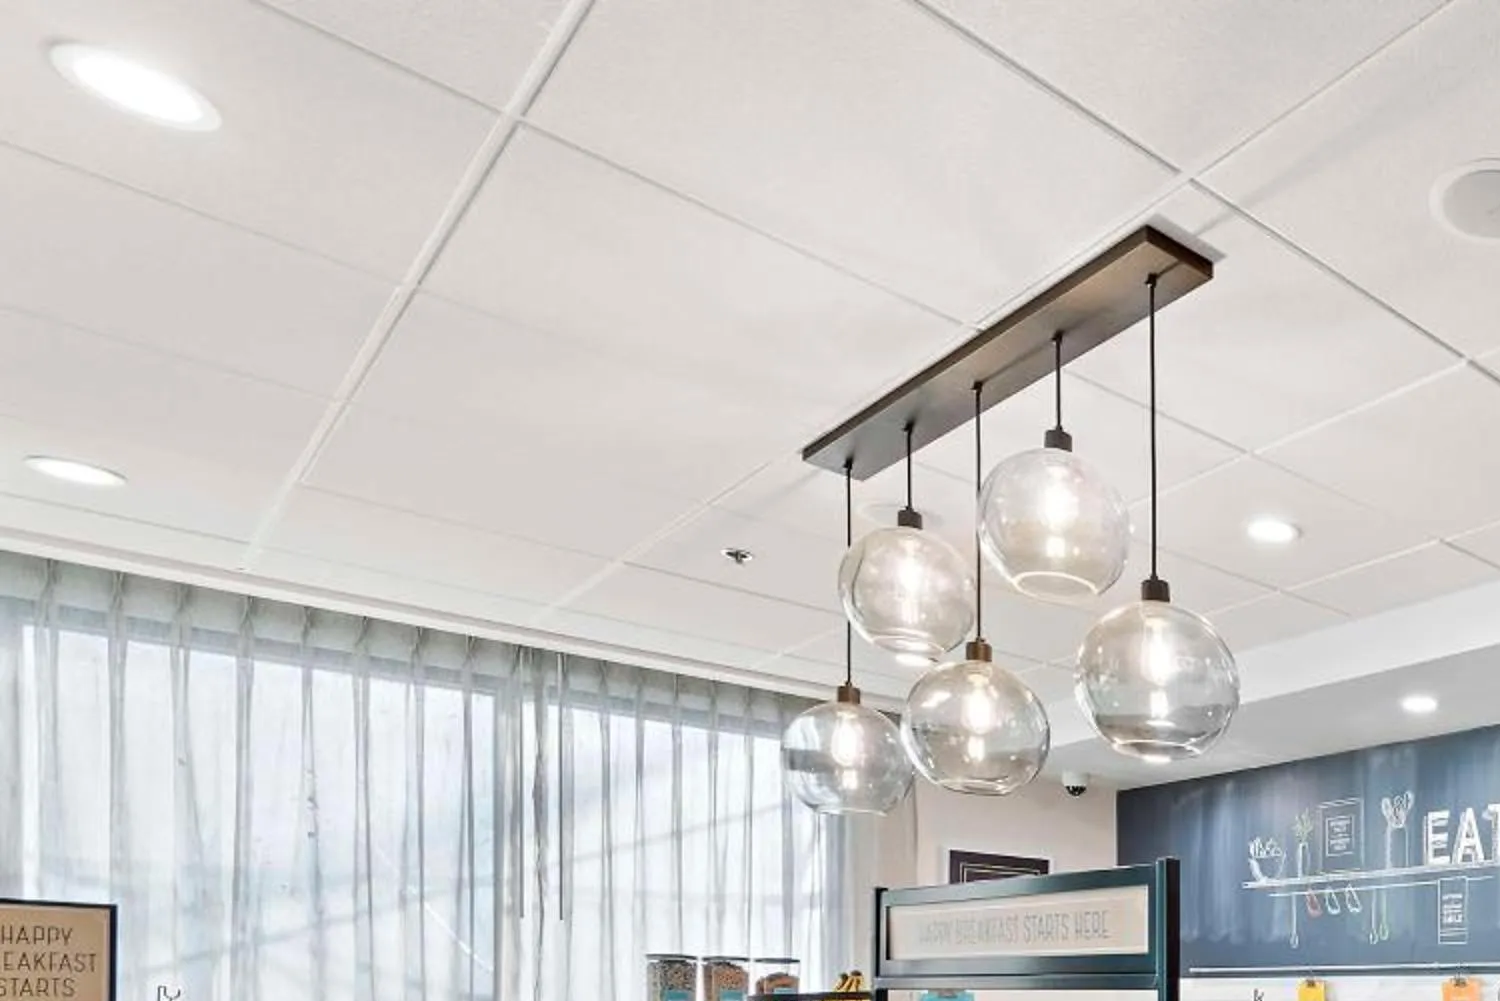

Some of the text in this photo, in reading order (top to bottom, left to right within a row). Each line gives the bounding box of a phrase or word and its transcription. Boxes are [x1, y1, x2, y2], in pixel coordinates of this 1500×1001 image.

[1, 925, 73, 945] HAPPY
[1023, 911, 1070, 944] STARTS
[1074, 909, 1112, 940] HERE
[3, 951, 97, 973] EAKFAST
[0, 977, 76, 998] STARTS
